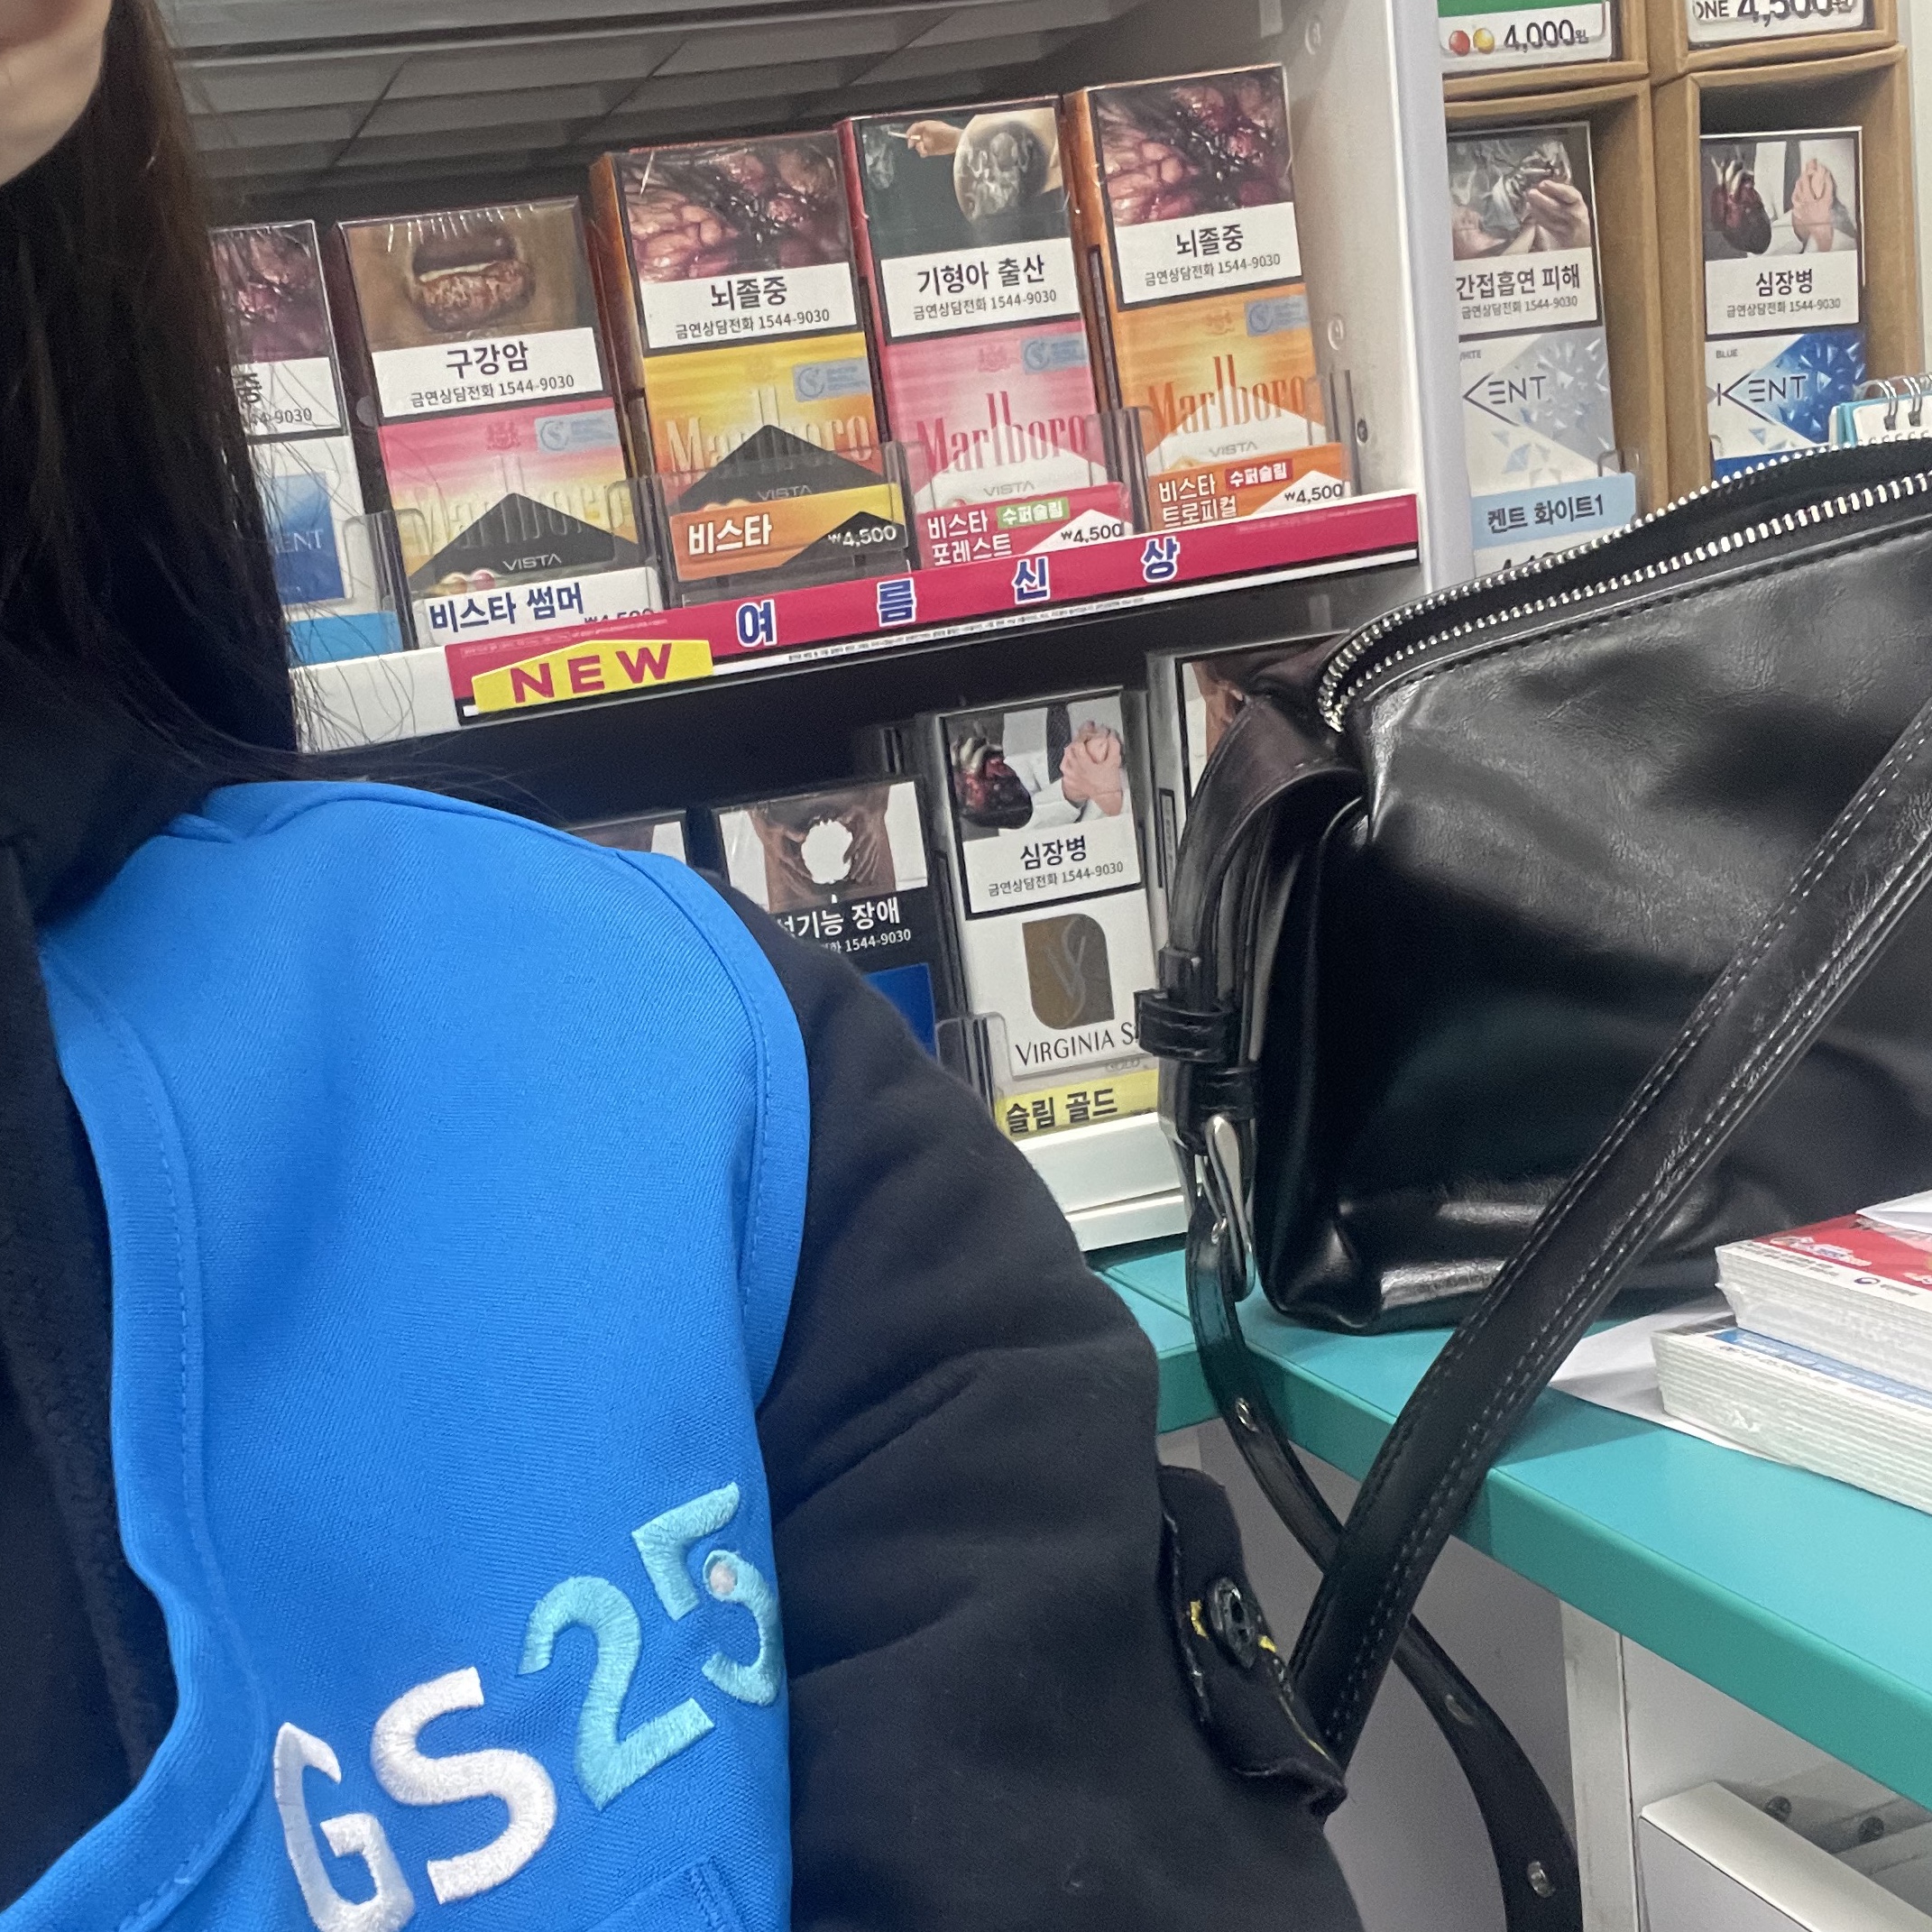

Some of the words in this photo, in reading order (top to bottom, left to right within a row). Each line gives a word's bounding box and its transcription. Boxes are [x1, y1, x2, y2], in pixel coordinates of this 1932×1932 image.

[1176, 224, 1244, 258] 뇌졸중
[917, 261, 989, 297] 기형아
[998, 254, 1045, 288] 출산
[1145, 262, 1215, 287] 금연상담전화
[1218, 253, 1281, 274] 1544-9030
[1456, 269, 1536, 301] 간접흡연
[1541, 263, 1580, 291] 피해
[1755, 269, 1813, 298] 심장병
[711, 276, 787, 311] 뇌졸중
[913, 298, 988, 321] 금연상담전화
[991, 290, 1057, 310] 1544-9030
[1461, 300, 1522, 320] 금연상담전화
[1525, 296, 1578, 312] 1544-9030
[1726, 301, 1786, 318] 금연상담전화
[1789, 299, 1841, 313] 1544-9030
[676, 317, 754, 340] 금연상담전화
[759, 308, 830, 329] 1544-9030
[446, 341, 529, 380] 구강암
[410, 382, 495, 409] 금연상담전화
[499, 374, 575, 396] 1544-9030
[1147, 354, 1306, 437] Marlboro
[1716, 370, 1807, 426] KENT
[916, 390, 1088, 474] Marlboro
[1209, 440, 1258, 457] VISTA
[983, 479, 1035, 497] VISTA
[1159, 473, 1216, 502] 비스타
[1229, 462, 1288, 488] 수퍼슬림
[1285, 483, 1343, 503] ₩4,500
[927, 510, 989, 539] 비스타
[1002, 500, 1063, 525] 수퍼슬림
[1162, 495, 1237, 529] 트로피컬
[1487, 507, 1529, 534] 켄트
[1534, 494, 1603, 526] 화이트1
[687, 513, 773, 556] 비스타
[932, 533, 1013, 566] 포레스트
[502, 553, 562, 571] VISTA
[428, 592, 517, 633] 비스타
[527, 582, 584, 621] 썸머
[510, 643, 673, 704] NEW
[1020, 835, 1087, 871] 심장병
[989, 872, 1058, 897] 금연상담전화
[1062, 861, 1124, 883] 1544-9030
[851, 897, 900, 931] 장애
[845, 928, 912, 953] 1544-9030
[1016, 1029, 1116, 1066] VIRGINIA
[1007, 1097, 1056, 1135] 슬림
[1065, 1088, 1118, 1124] 골드
[272, 1481, 787, 1932] GS25
